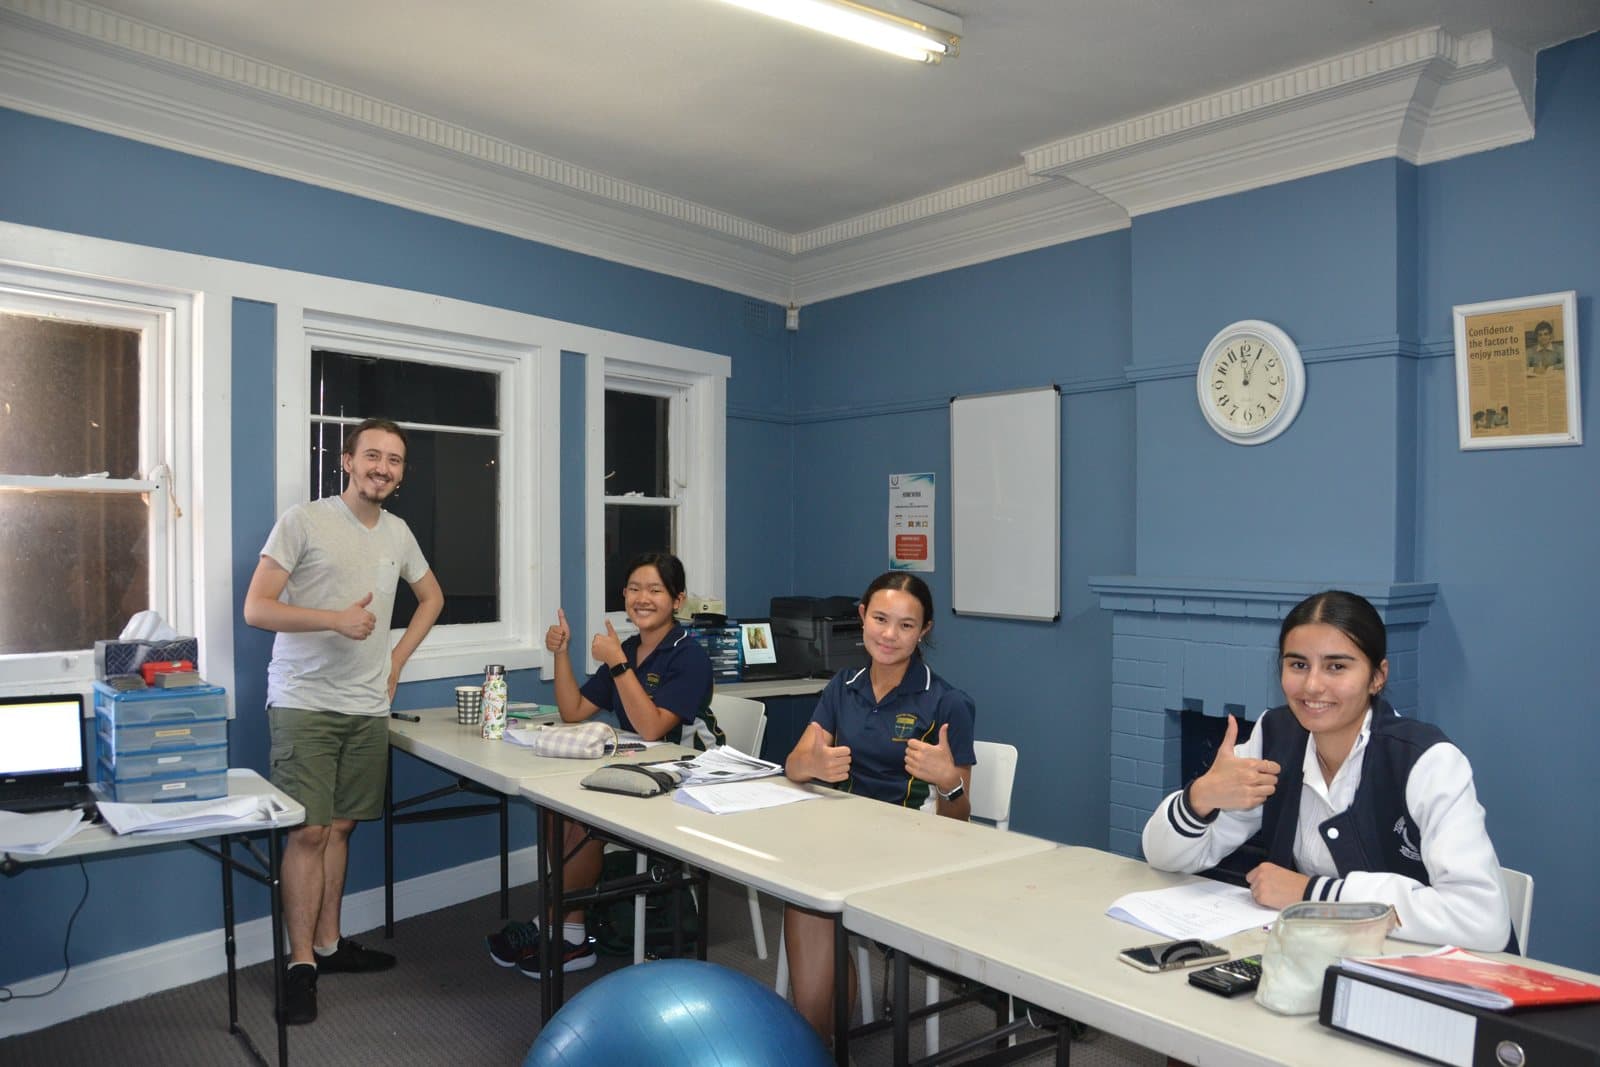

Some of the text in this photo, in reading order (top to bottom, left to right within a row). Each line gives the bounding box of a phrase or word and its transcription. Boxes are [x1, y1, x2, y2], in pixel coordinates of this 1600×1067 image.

[1468, 324, 1514, 337] Confidence
[1469, 336, 1519, 349] the factor to
[1470, 347, 1520, 361] enjoy maths
